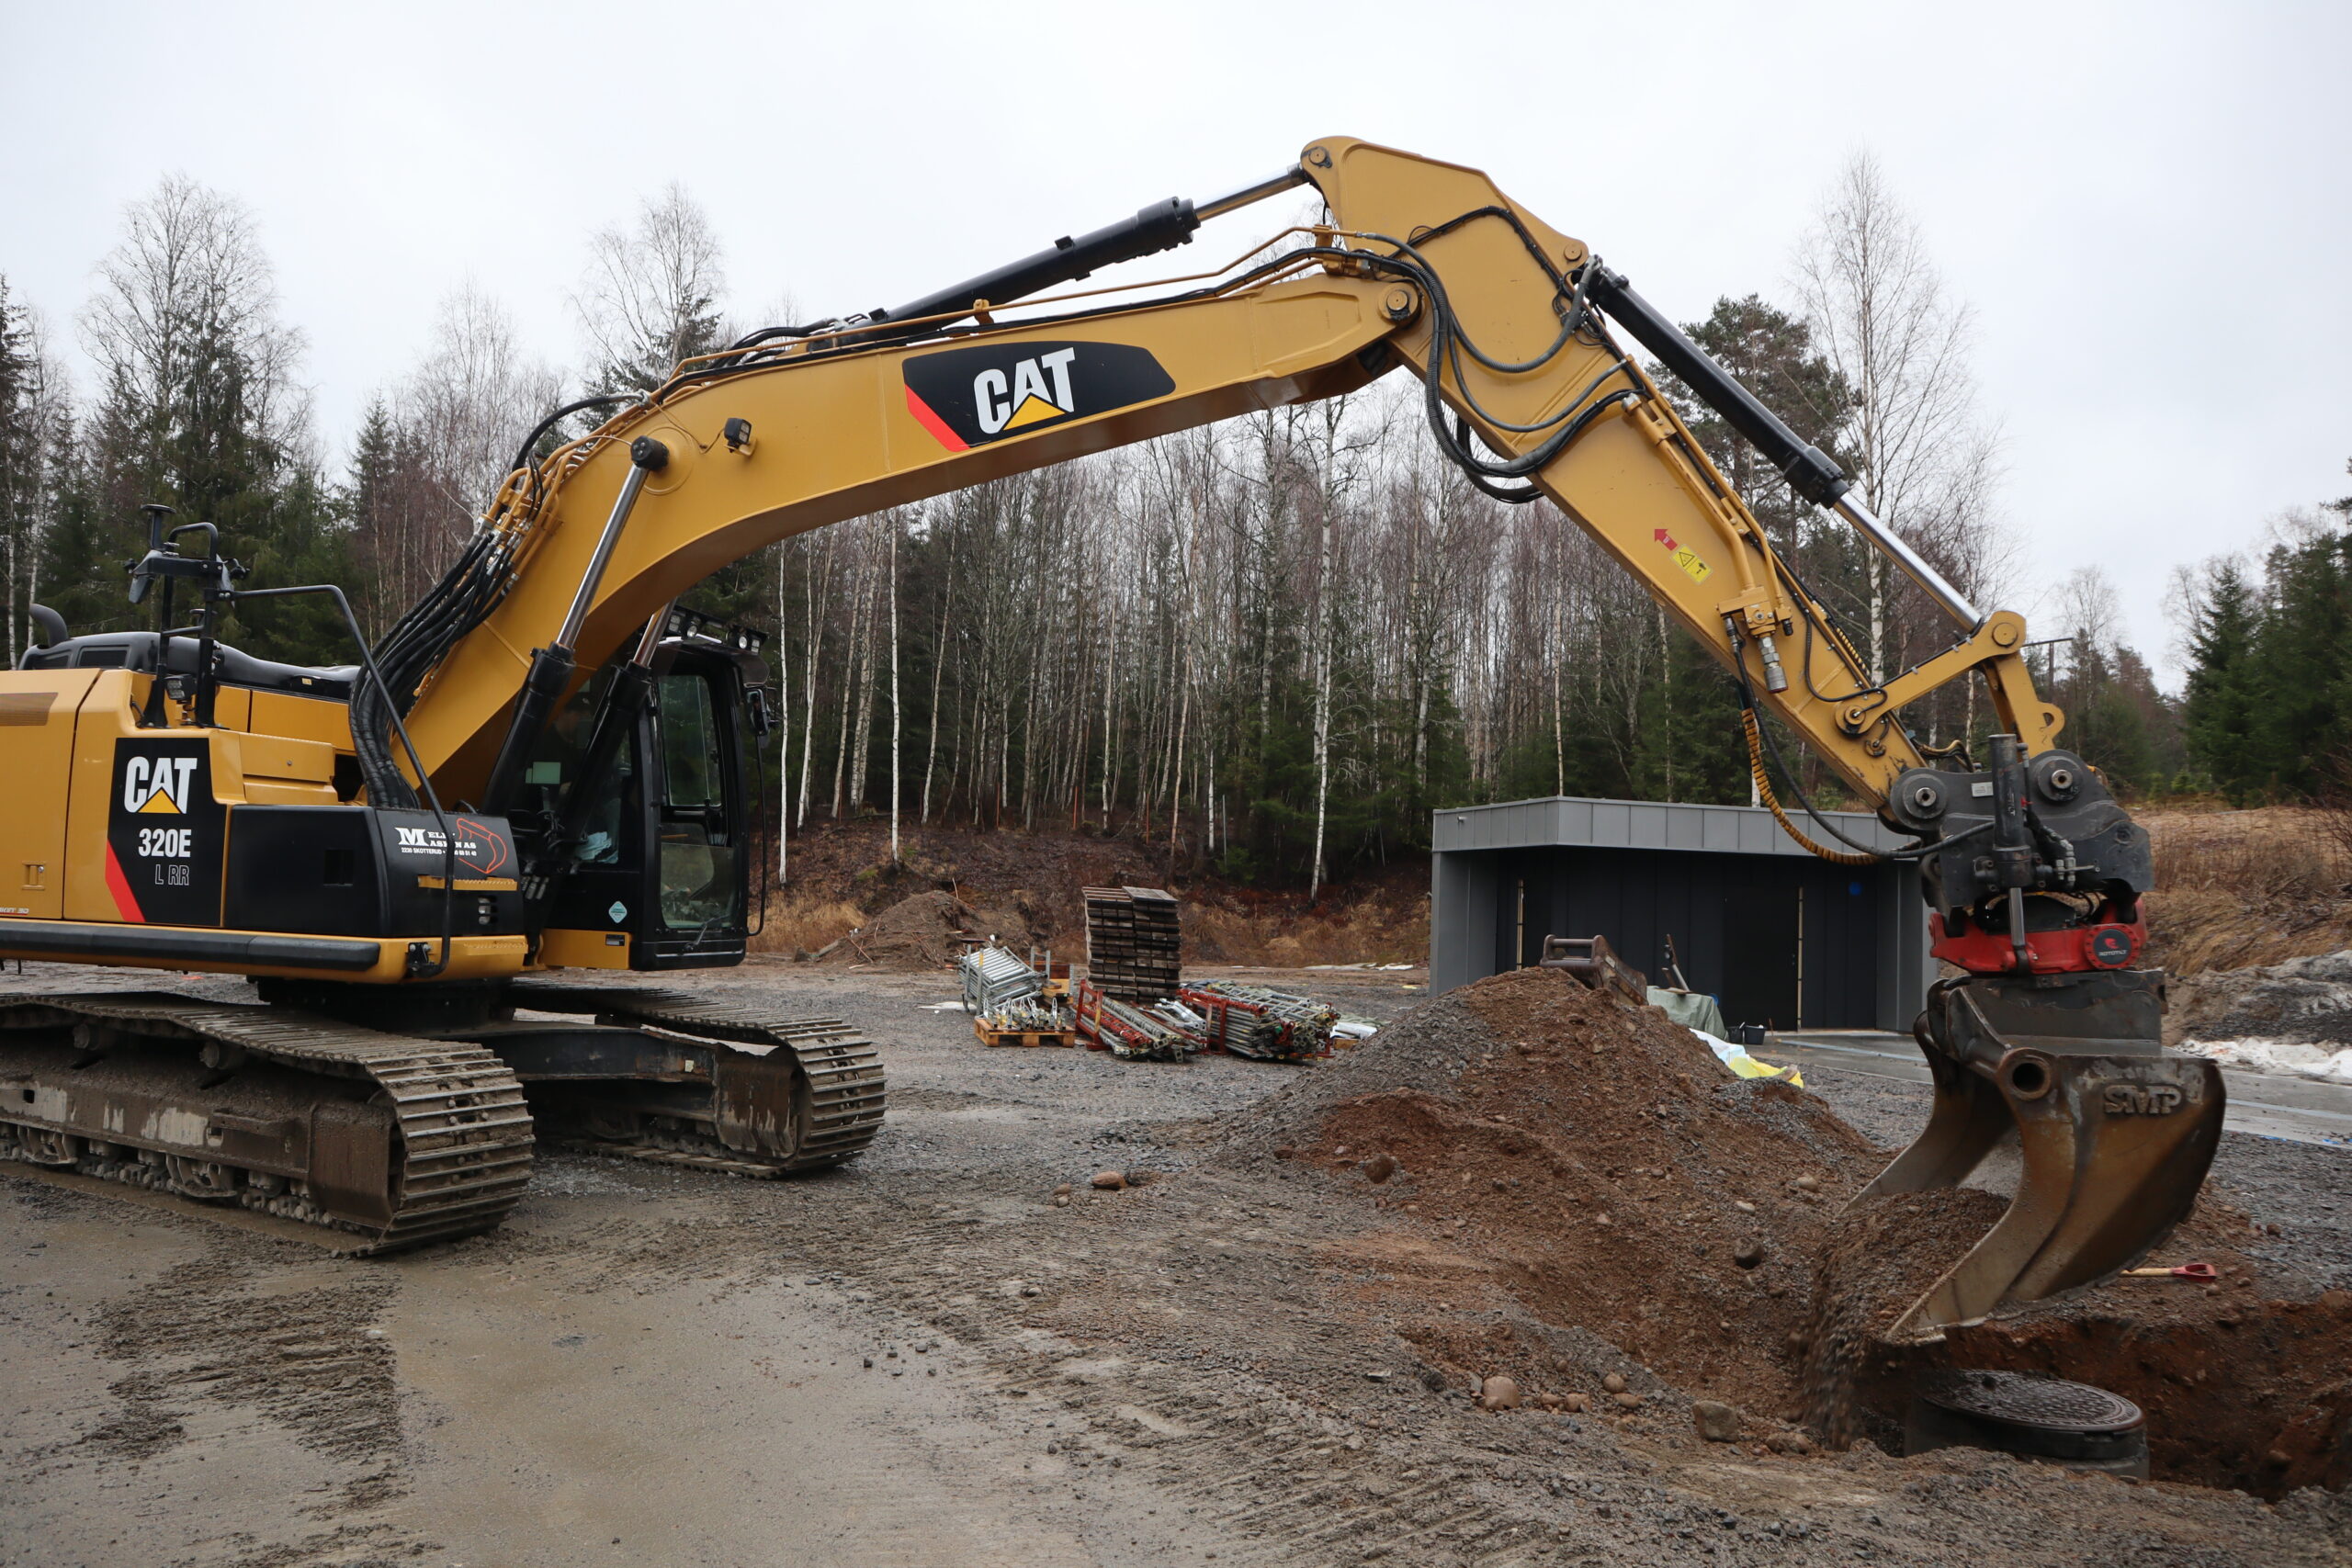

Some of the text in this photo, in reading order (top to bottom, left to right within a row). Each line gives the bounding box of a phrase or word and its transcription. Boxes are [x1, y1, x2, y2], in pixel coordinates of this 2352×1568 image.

[974, 347, 1075, 434] CAT
[124, 756, 198, 814] CAT
[138, 829, 192, 857] 320E
[154, 864, 190, 886] L RR
[2103, 1084, 2182, 1115] SMP
